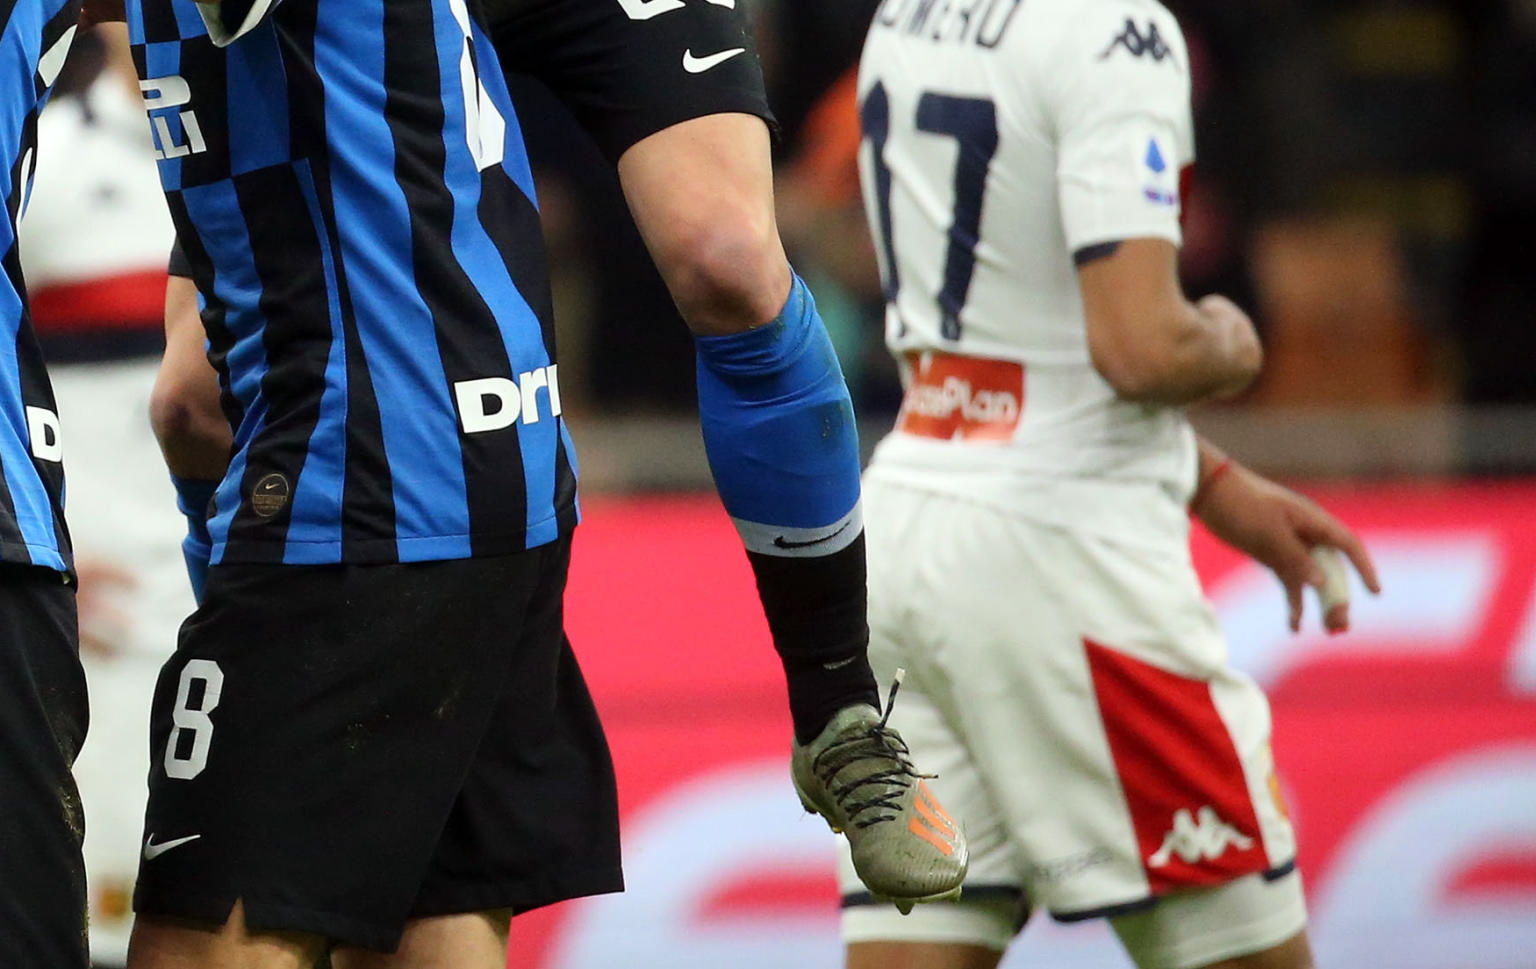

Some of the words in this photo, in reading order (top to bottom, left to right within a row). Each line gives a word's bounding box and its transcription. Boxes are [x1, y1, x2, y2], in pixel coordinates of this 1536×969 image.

[859, 77, 999, 341] 17
[454, 363, 562, 434] Dri
[164, 659, 224, 780] 8
